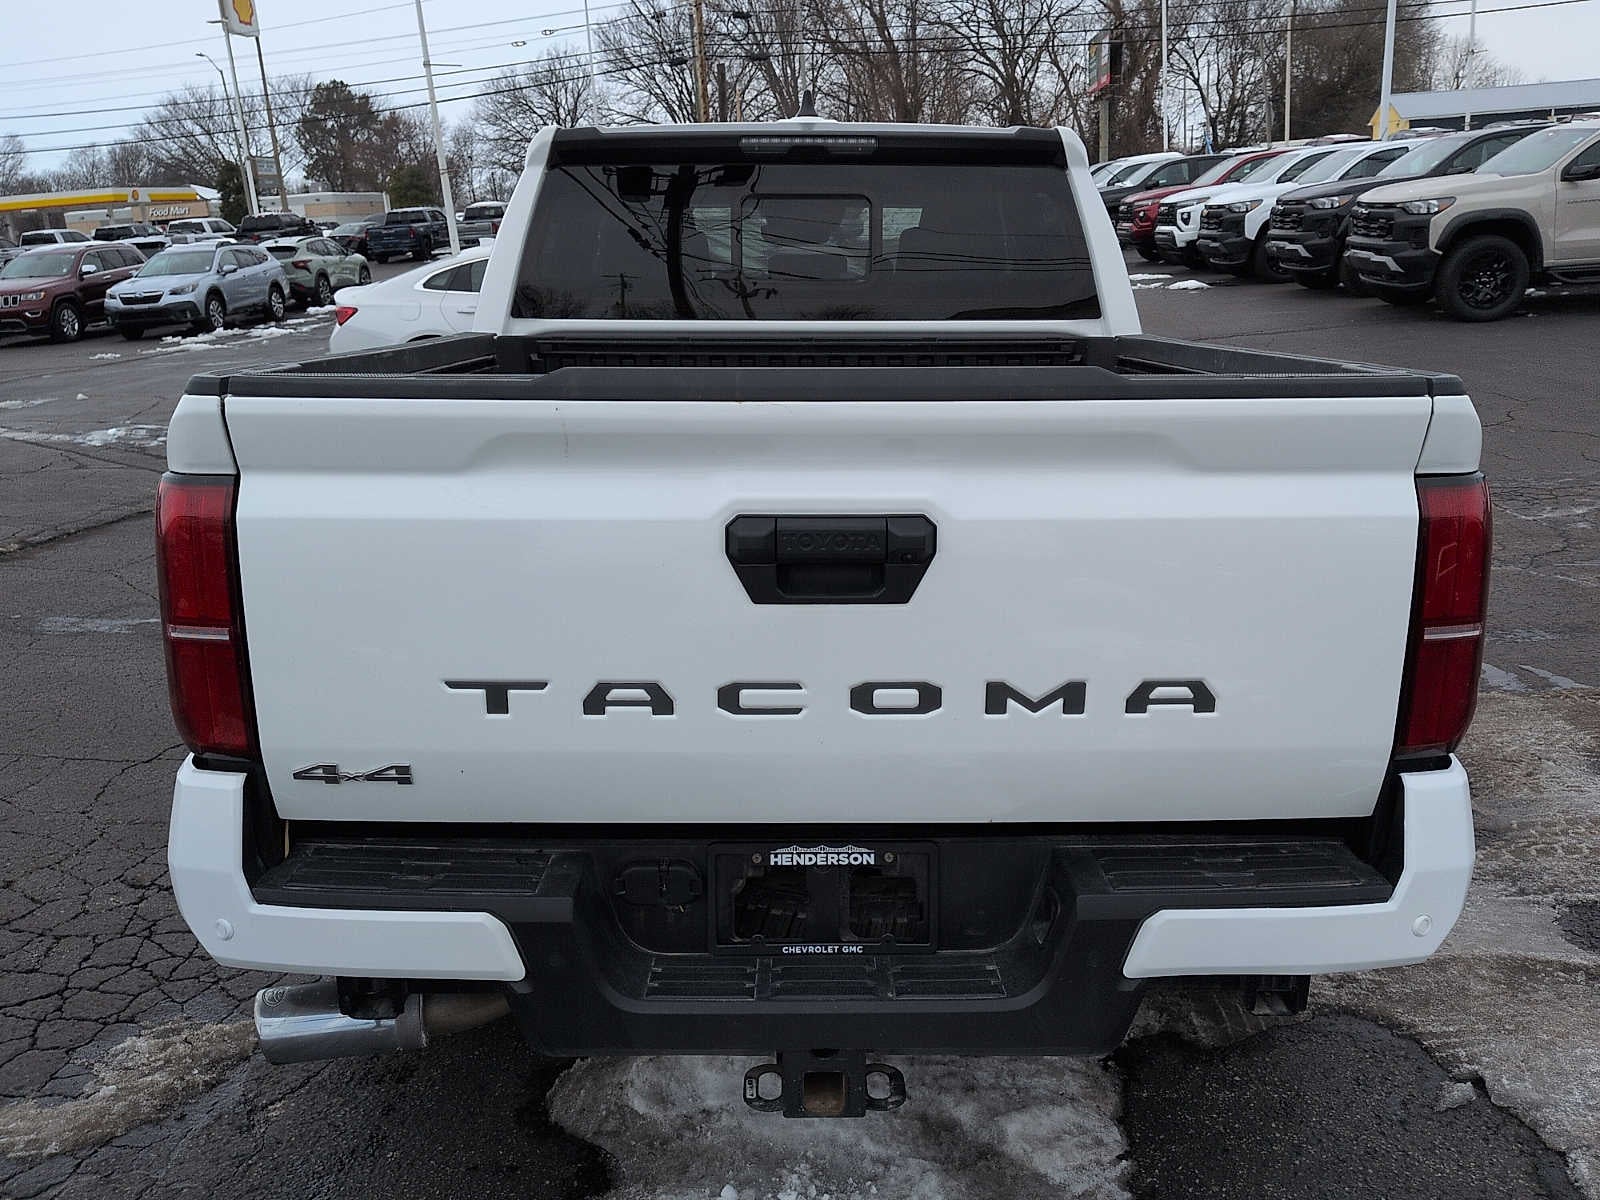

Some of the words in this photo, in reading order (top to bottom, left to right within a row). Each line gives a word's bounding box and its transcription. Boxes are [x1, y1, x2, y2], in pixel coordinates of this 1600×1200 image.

[149, 206, 169, 217] Food
[170, 206, 189, 216] Mart
[782, 533, 881, 551] TOYOTA
[444, 679, 1216, 717] TACOMA
[770, 853, 875, 866] HENDERSON
[782, 946, 839, 954] CHEVROLET
[841, 946, 864, 954] GMC
